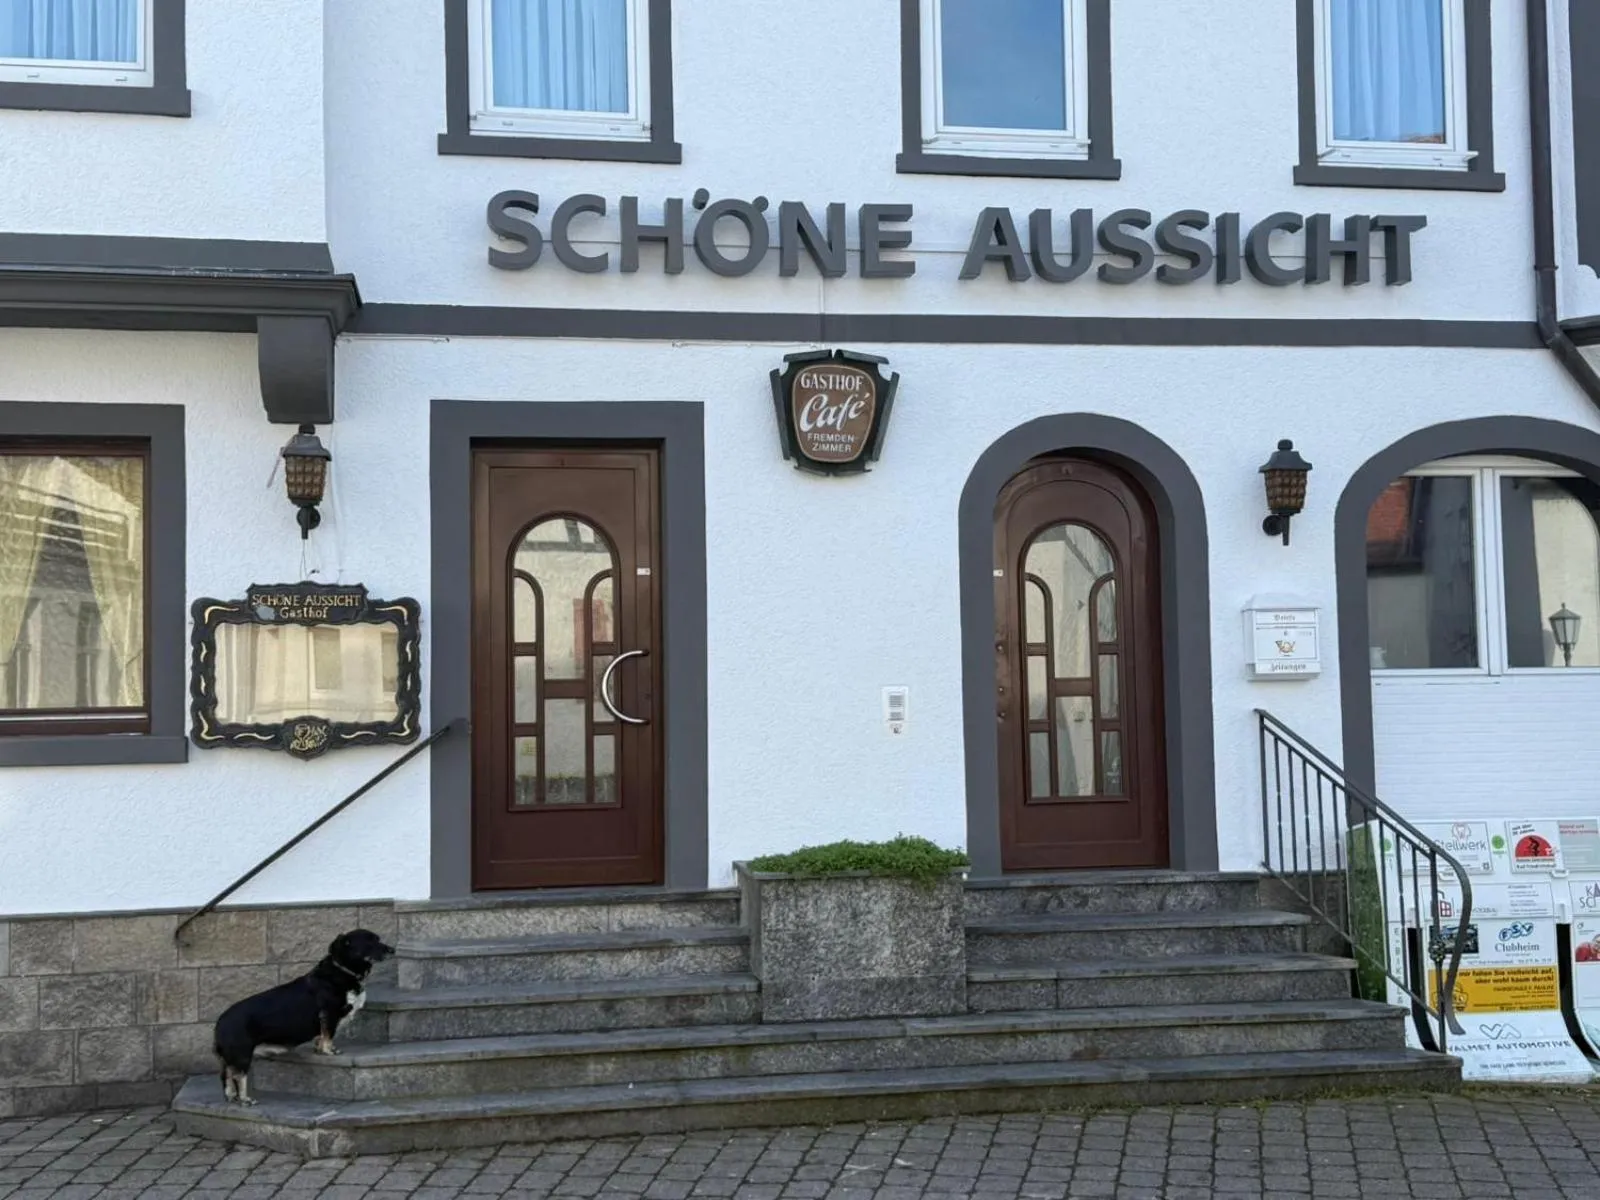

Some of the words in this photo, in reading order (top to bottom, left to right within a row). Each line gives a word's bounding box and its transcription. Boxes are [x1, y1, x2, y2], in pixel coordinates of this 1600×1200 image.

[487, 188, 916, 279] SCHÖNE
[958, 206, 1427, 286] AUSSICHT
[800, 373, 864, 391] GASTHOF
[799, 392, 871, 432] Café
[807, 433, 855, 442] FREMDEN
[812, 443, 852, 452] ZIMMER
[304, 594, 362, 607] AUSSICHT
[279, 607, 328, 619] Gasthof
[1500, 922, 1533, 940] FSV
[1495, 942, 1540, 953] Clubheim
[1496, 1040, 1572, 1050] AUTOMOTIVE
